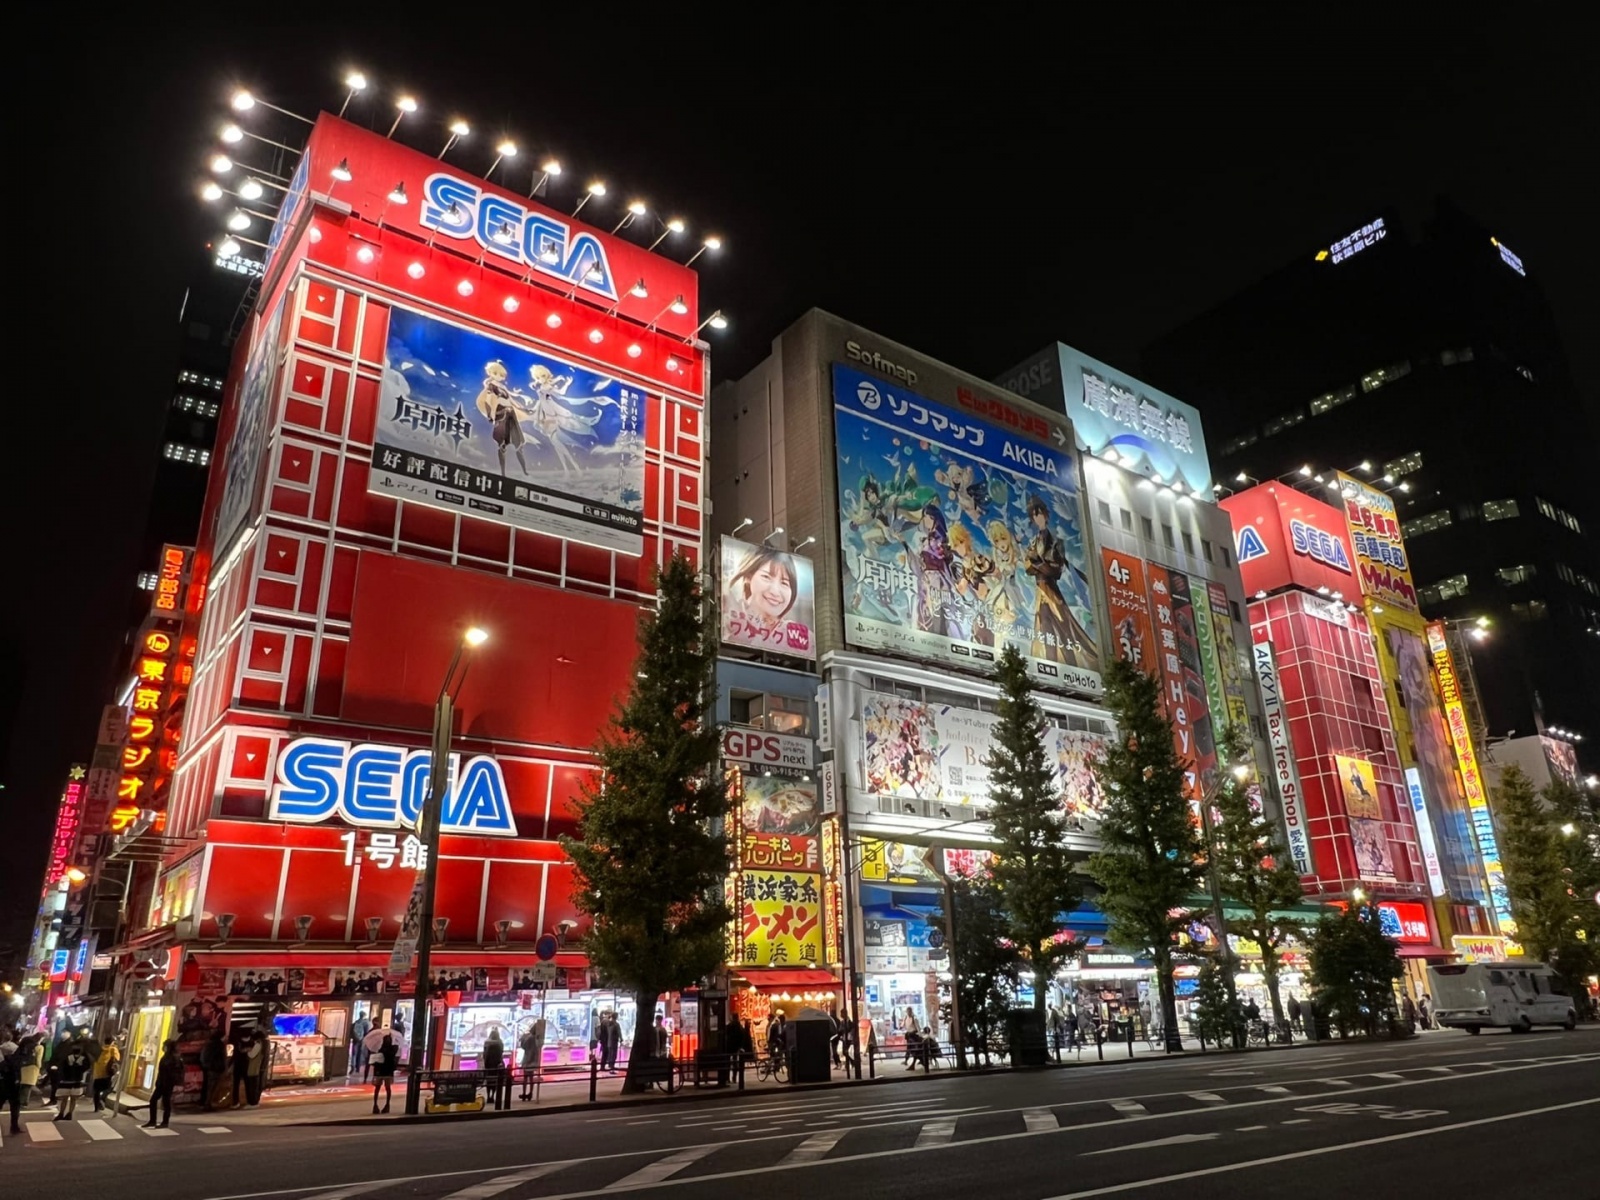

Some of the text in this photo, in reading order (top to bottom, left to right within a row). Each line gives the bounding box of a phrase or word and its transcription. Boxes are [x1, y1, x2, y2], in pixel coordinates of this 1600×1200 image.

[420, 172, 619, 302] SEGA
[846, 341, 918, 387] Sofmap
[390, 394, 472, 457] 原神
[887, 394, 985, 447] ソフマップ
[1002, 441, 1059, 478] AKIBA
[383, 450, 503, 496] 好評配信中！
[1289, 518, 1352, 574] SEGA
[857, 553, 919, 612] 原神
[1109, 559, 1130, 585] 4F
[1119, 637, 1142, 664] 3F
[1064, 672, 1096, 689] miHoYo
[723, 730, 782, 762] GPS
[783, 753, 807, 766] next
[269, 736, 518, 837] SEGA
[1268, 709, 1290, 780] Tax-free
[1282, 783, 1298, 827] Shop
[340, 832, 429, 870] 1号館
[743, 835, 791, 852] テーキ&
[745, 849, 804, 867] ハンバーグ
[743, 902, 819, 941] ラーメン
[743, 942, 818, 963] 横浜道
